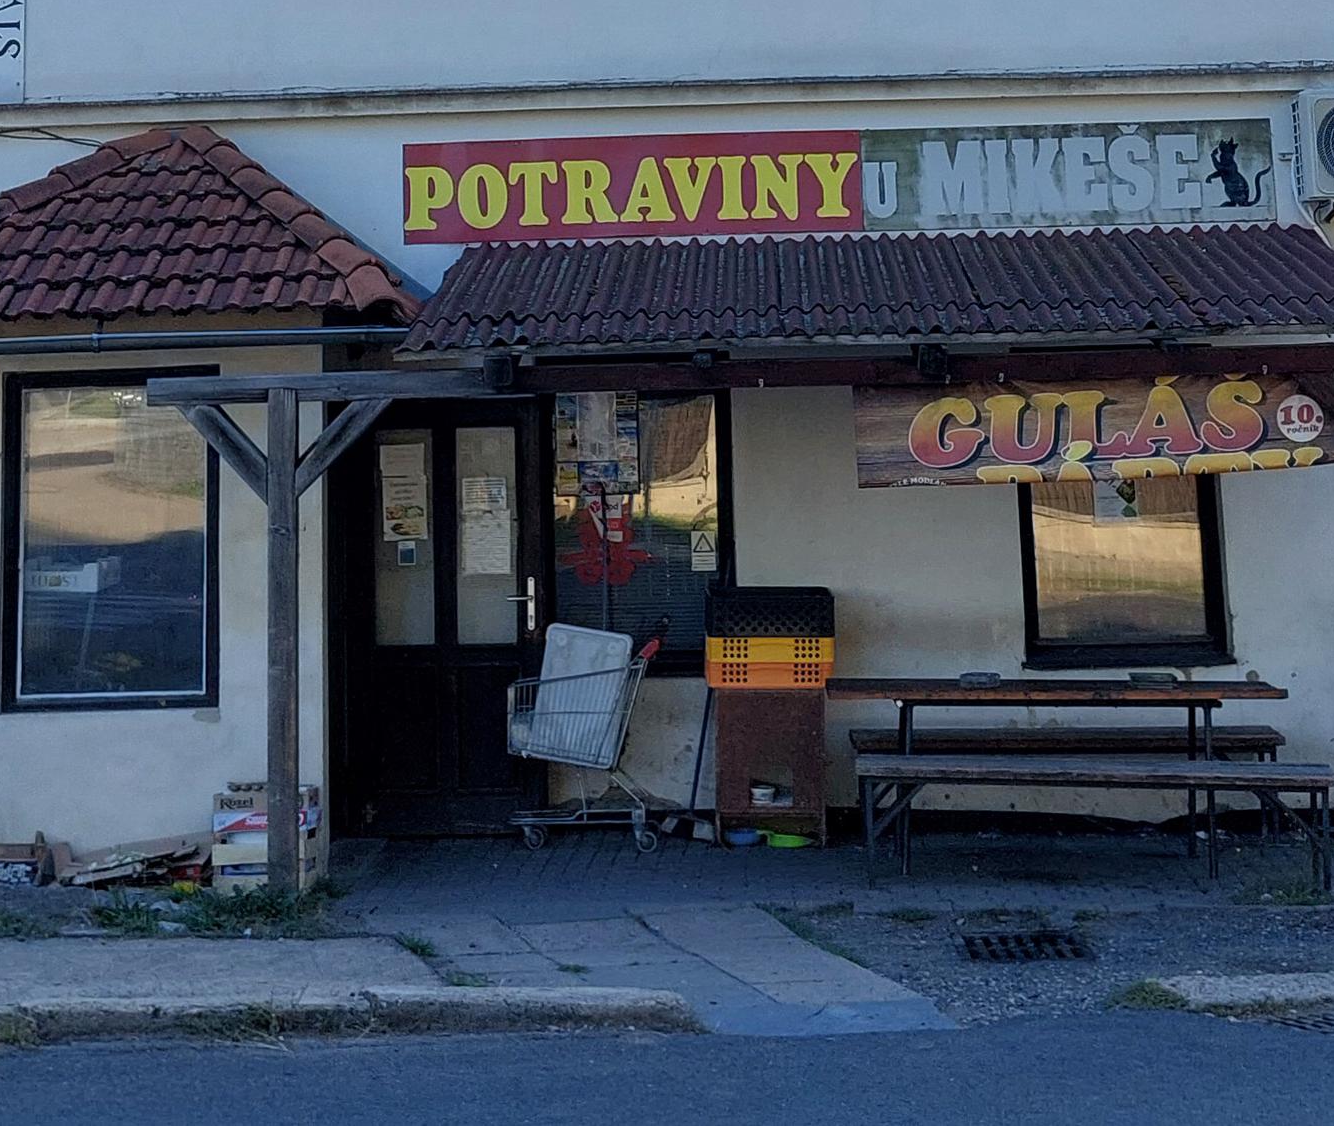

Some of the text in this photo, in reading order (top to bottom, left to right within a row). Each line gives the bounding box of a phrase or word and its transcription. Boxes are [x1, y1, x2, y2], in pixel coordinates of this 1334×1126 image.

[404, 152, 859, 231] POTRAVINY
[919, 124, 1204, 218] MIKEŠE
[908, 374, 1266, 469] GULÁŠ
[1280, 404, 1323, 426] 10.
[1287, 424, 1320, 434] ročník
